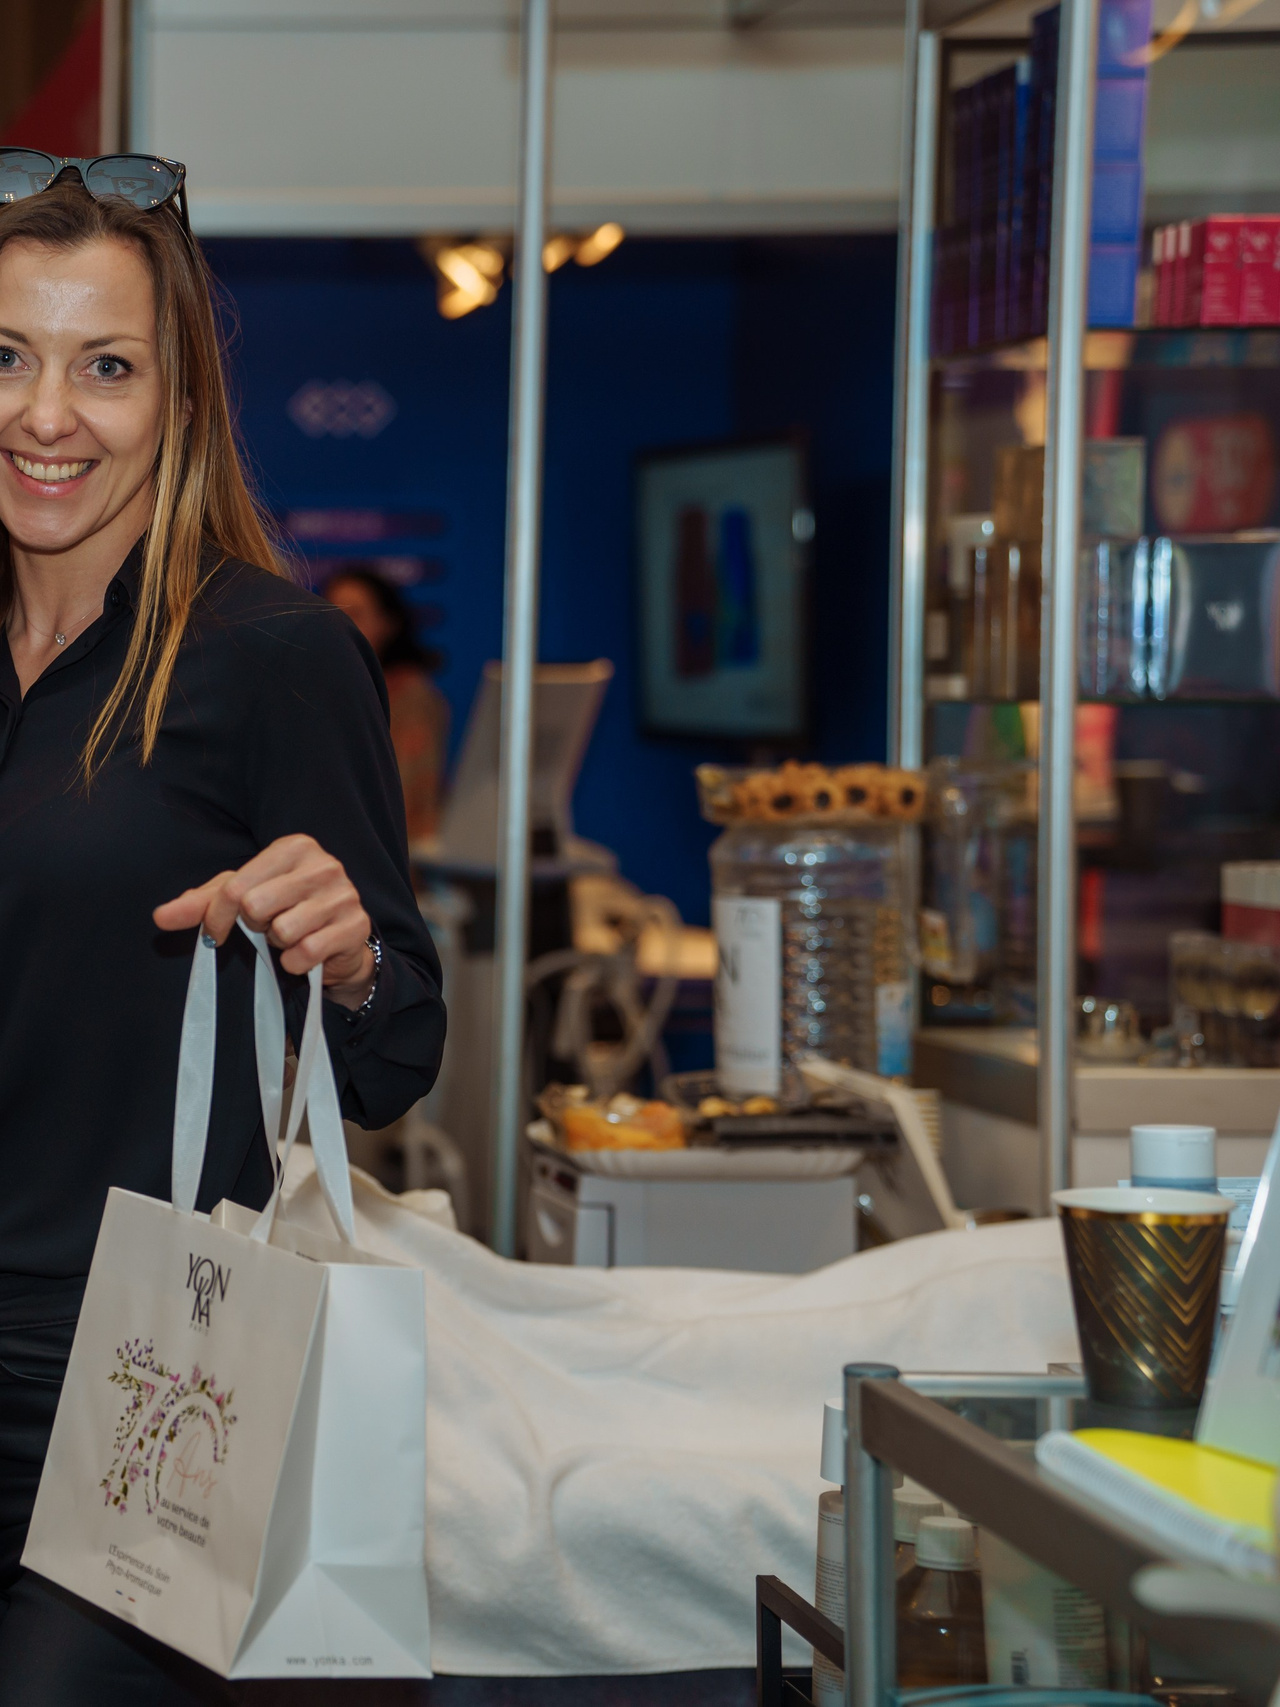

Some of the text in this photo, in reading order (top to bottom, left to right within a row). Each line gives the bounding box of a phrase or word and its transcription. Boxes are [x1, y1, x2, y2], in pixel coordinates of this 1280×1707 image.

[186, 1252, 232, 1303] YON
[191, 1275, 210, 1328] KA
[157, 1515, 178, 1535] votre
[171, 1502, 199, 1525] service
[199, 1515, 211, 1531] de
